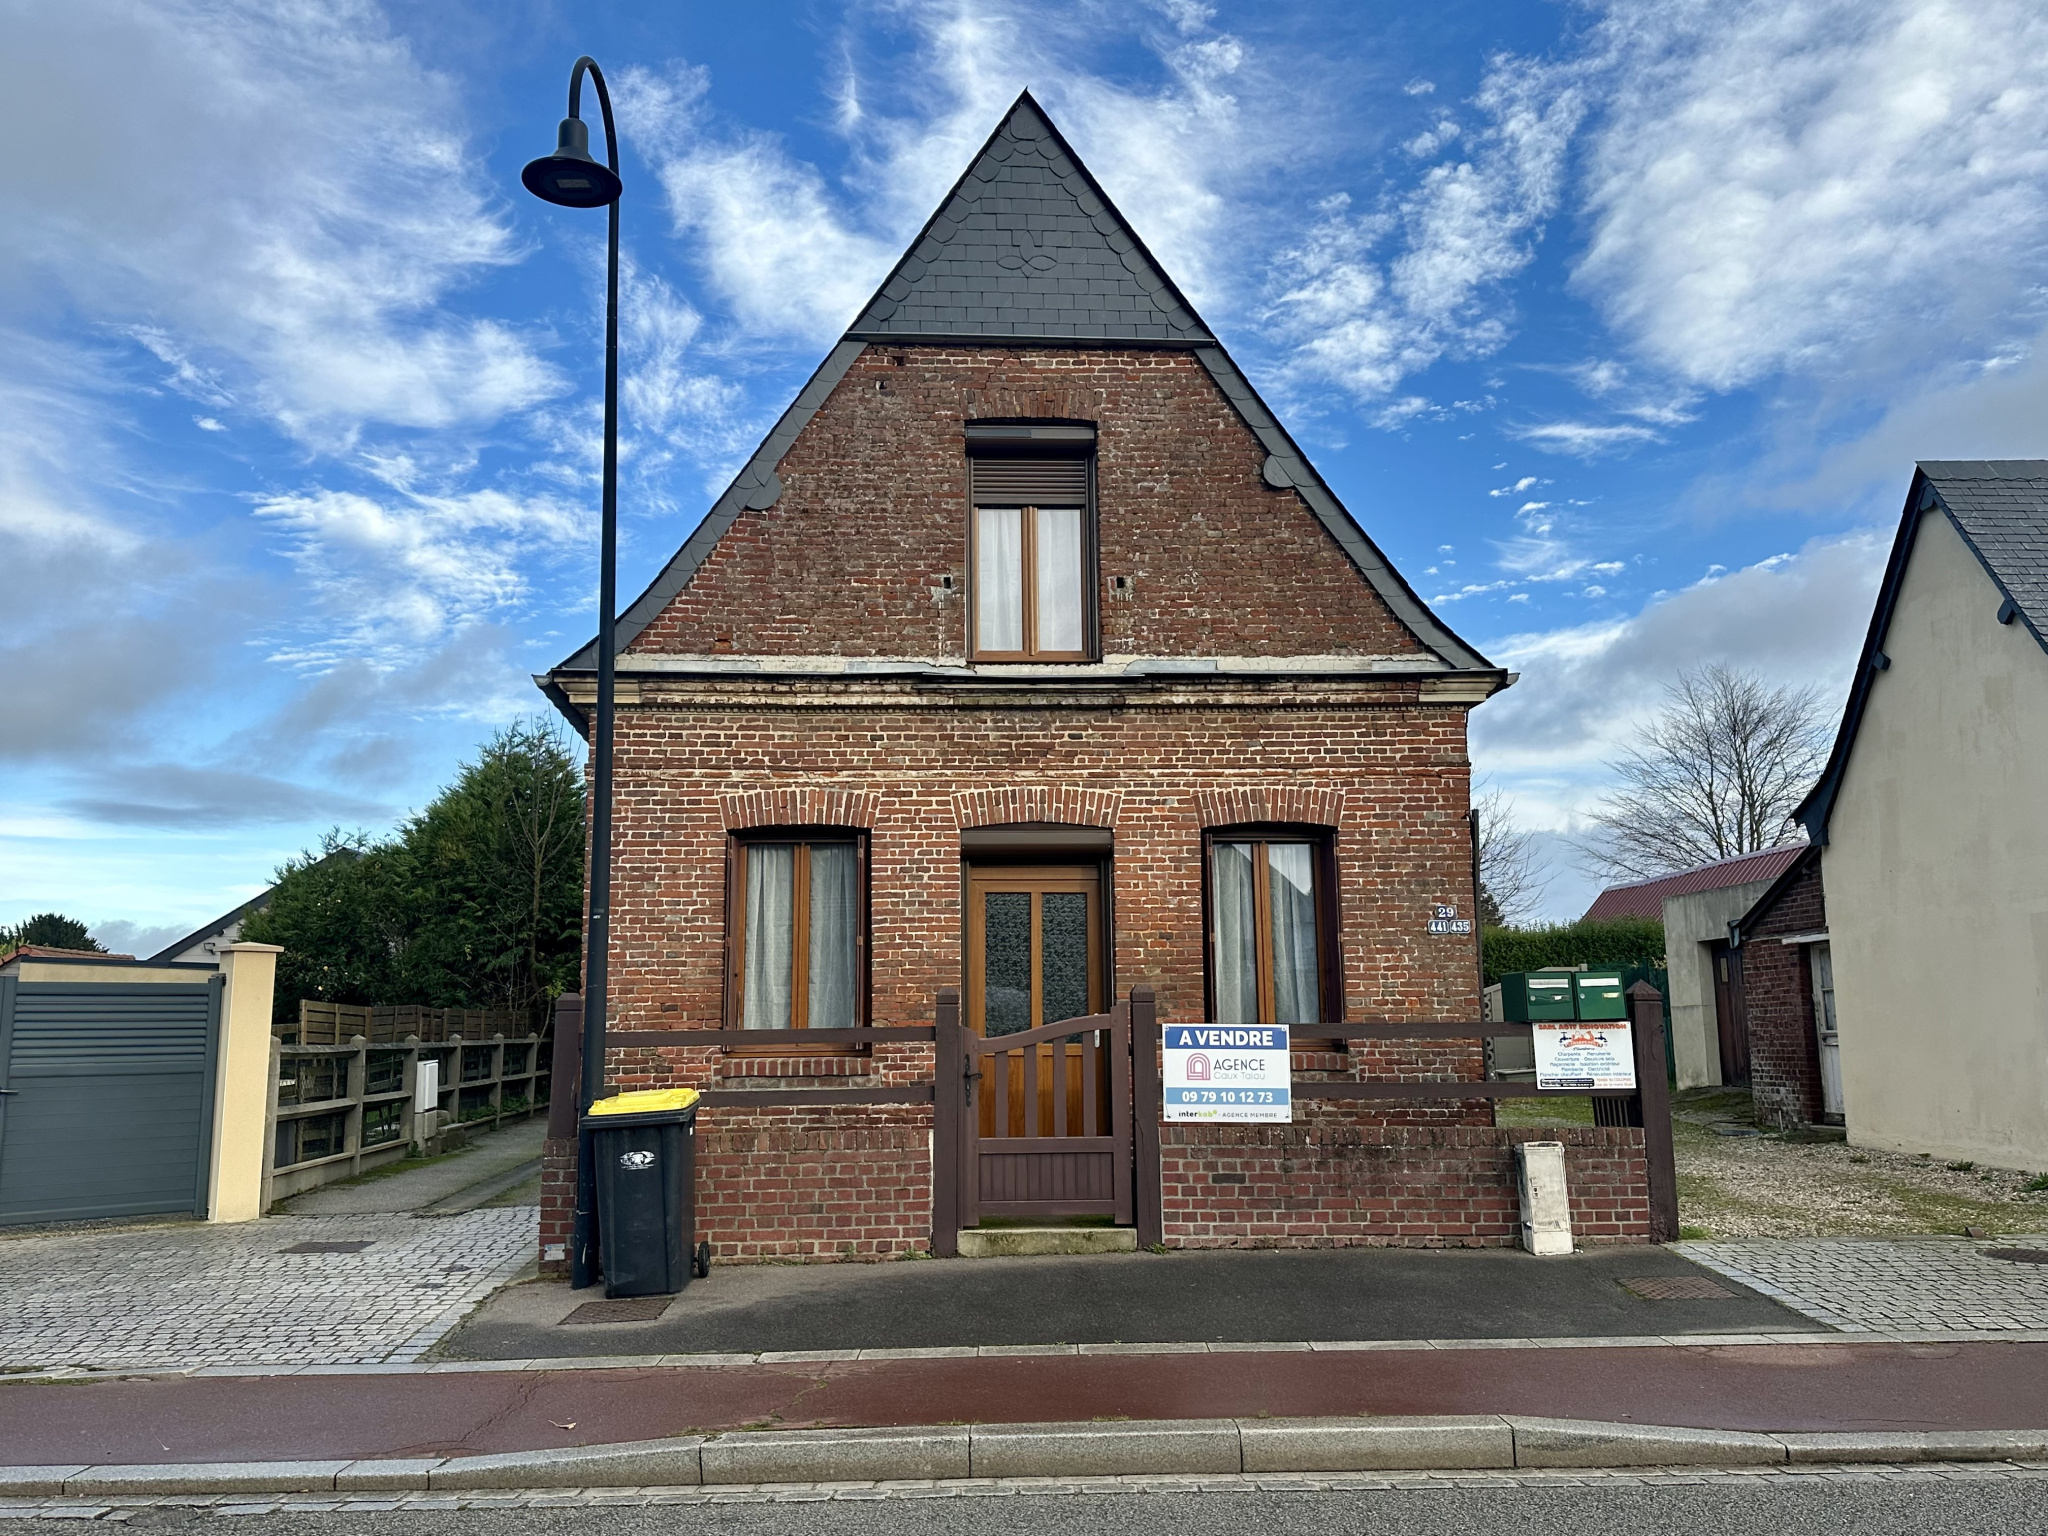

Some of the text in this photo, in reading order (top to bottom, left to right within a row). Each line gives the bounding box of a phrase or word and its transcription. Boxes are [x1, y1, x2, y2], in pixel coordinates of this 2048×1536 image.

[1438, 907, 1455, 918] 29
[1430, 921, 1447, 932] 441
[1451, 921, 1469, 932] 435
[1178, 1030, 1274, 1047] A VENDRE
[1213, 1058, 1266, 1071] AGENCE
[1181, 1091, 1274, 1103] 09 79 10 12 73
